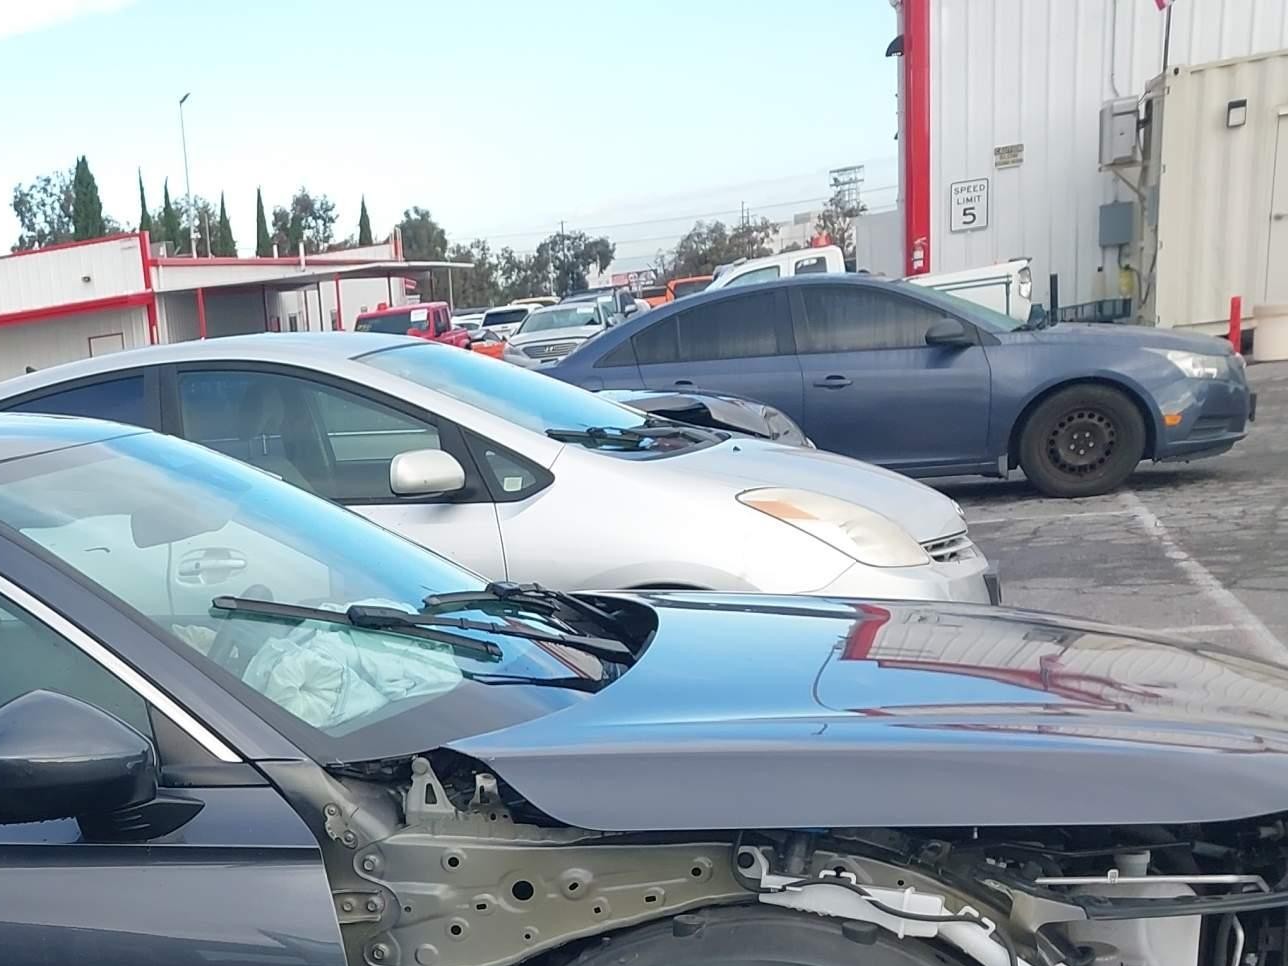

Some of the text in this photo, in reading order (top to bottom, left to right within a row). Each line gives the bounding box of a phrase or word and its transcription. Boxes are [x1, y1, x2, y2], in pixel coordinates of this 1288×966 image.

[953, 184, 986, 195] SPEED
[956, 195, 981, 205] LIMIT
[962, 206, 976, 225] 5
